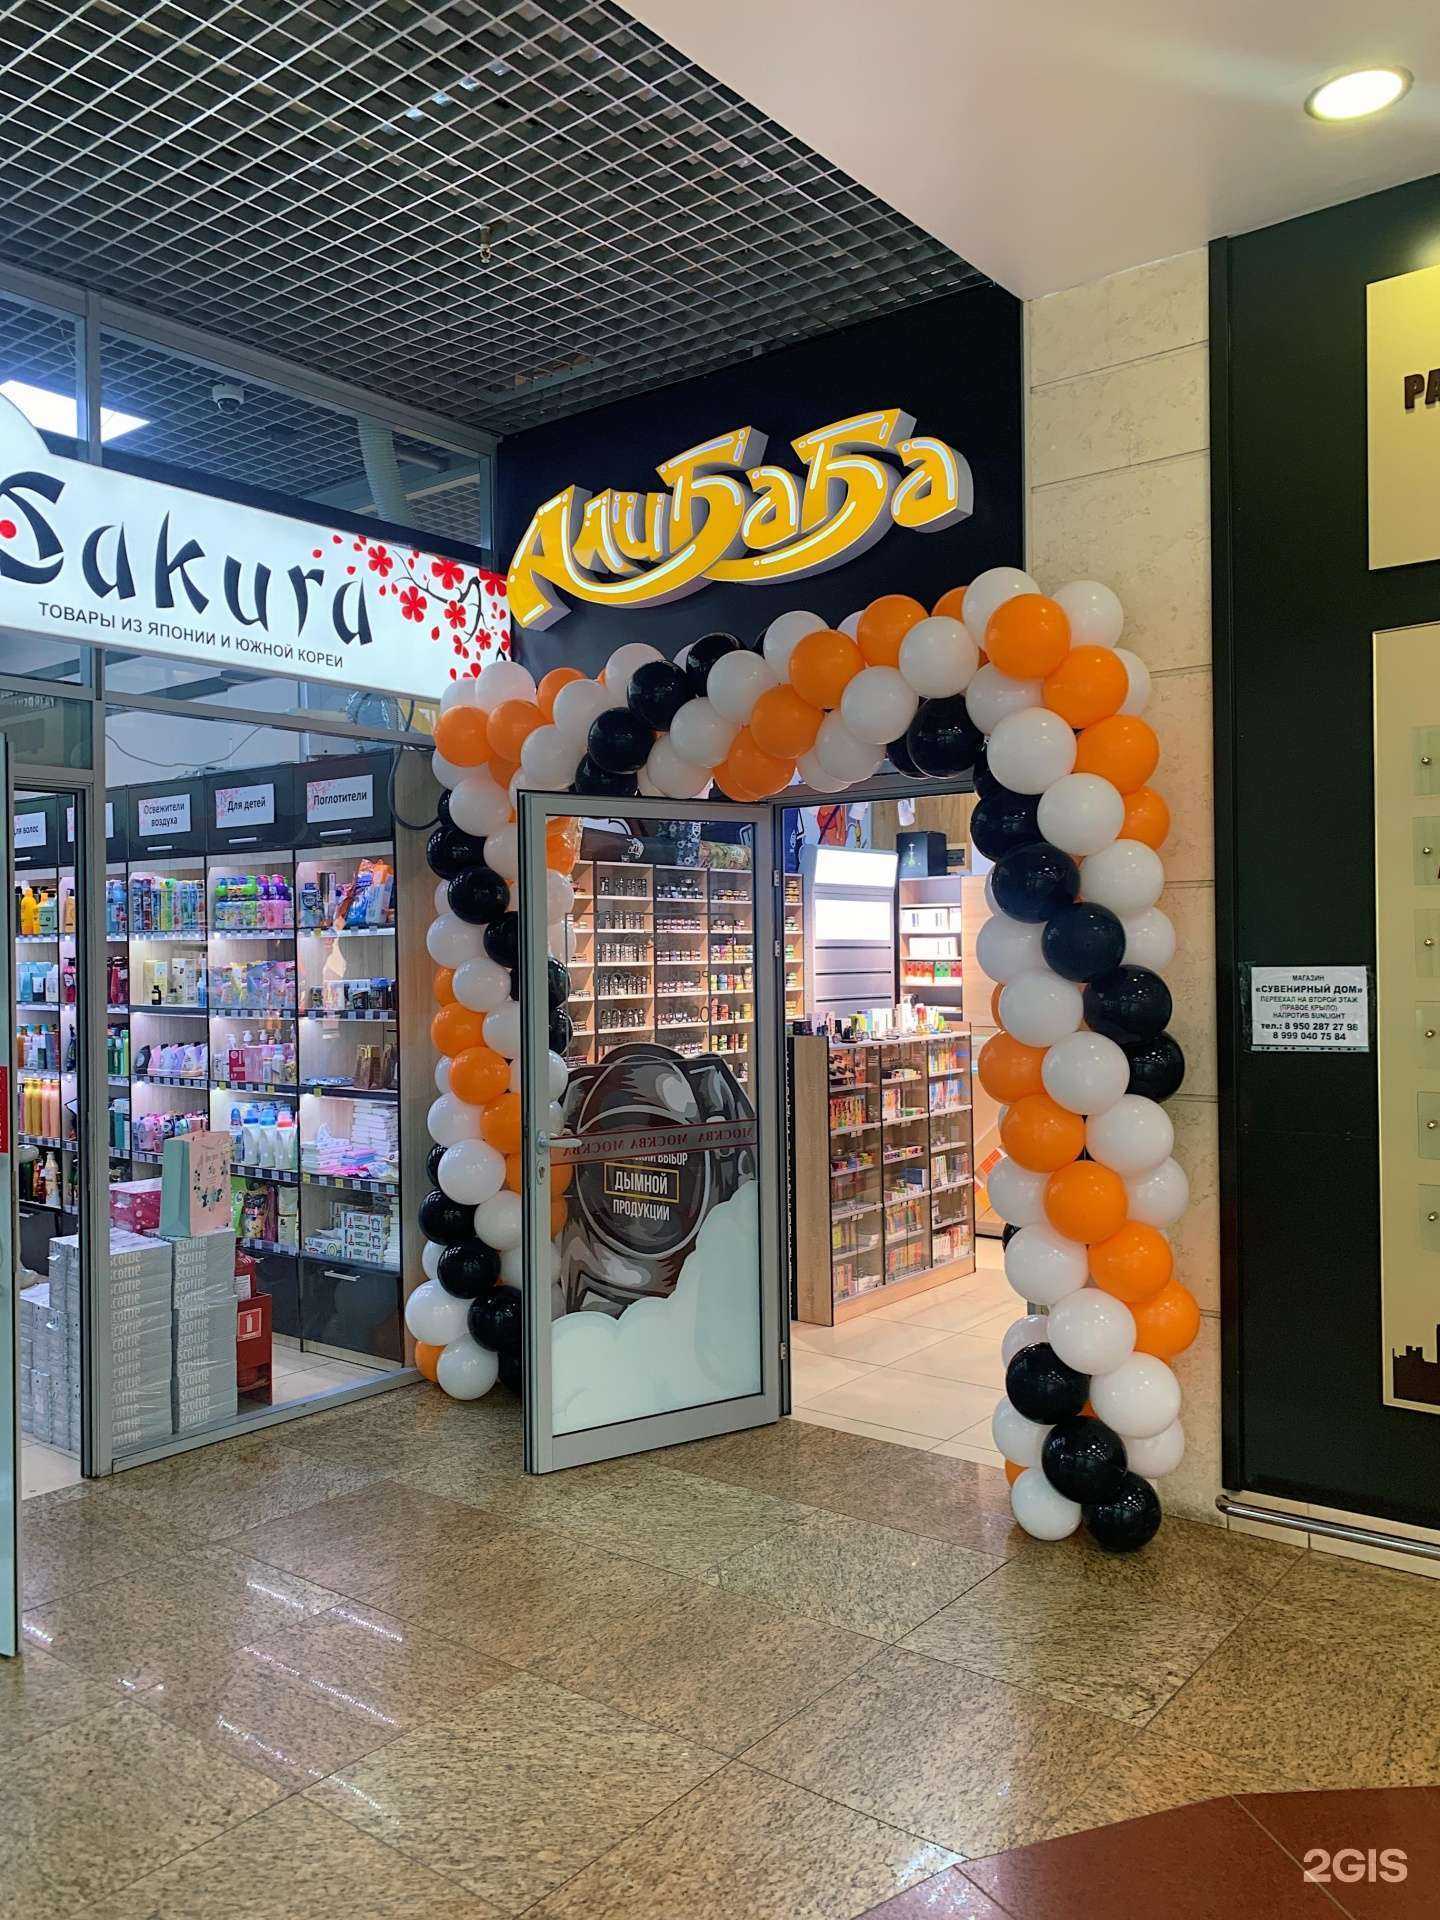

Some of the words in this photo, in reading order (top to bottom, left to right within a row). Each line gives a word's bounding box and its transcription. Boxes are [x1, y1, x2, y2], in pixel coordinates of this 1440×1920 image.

[0, 471, 373, 646] Sakura
[38, 602, 116, 629] ТОВАРЫ
[121, 616, 143, 633] ИЗ
[148, 622, 217, 646] ЯПОНИИ
[220, 634, 233, 649] И
[235, 638, 294, 660] ЮЖНОЙ
[298, 648, 344, 669] КОРЕИ
[313, 791, 367, 806] Поглотители
[144, 803, 185, 815] Освежители
[227, 801, 243, 813] Для
[244, 797, 266, 811] детей
[151, 816, 179, 828] воздуха
[23, 825, 39, 835] волос
[1255, 984, 1331, 994] «СУВЕНИРНЫЙ
[1333, 985, 1363, 995] ДОМ»
[1308, 995, 1337, 1003] ВТОРОЙ
[1313, 1023, 1329, 1031] 287
[1281, 1032, 1298, 1040] 999
[1300, 1032, 1318, 1040] 040
[614, 1171, 668, 1195] ДЫМНОЙ
[613, 1200, 670, 1221] ПРОДУКЦИИ
